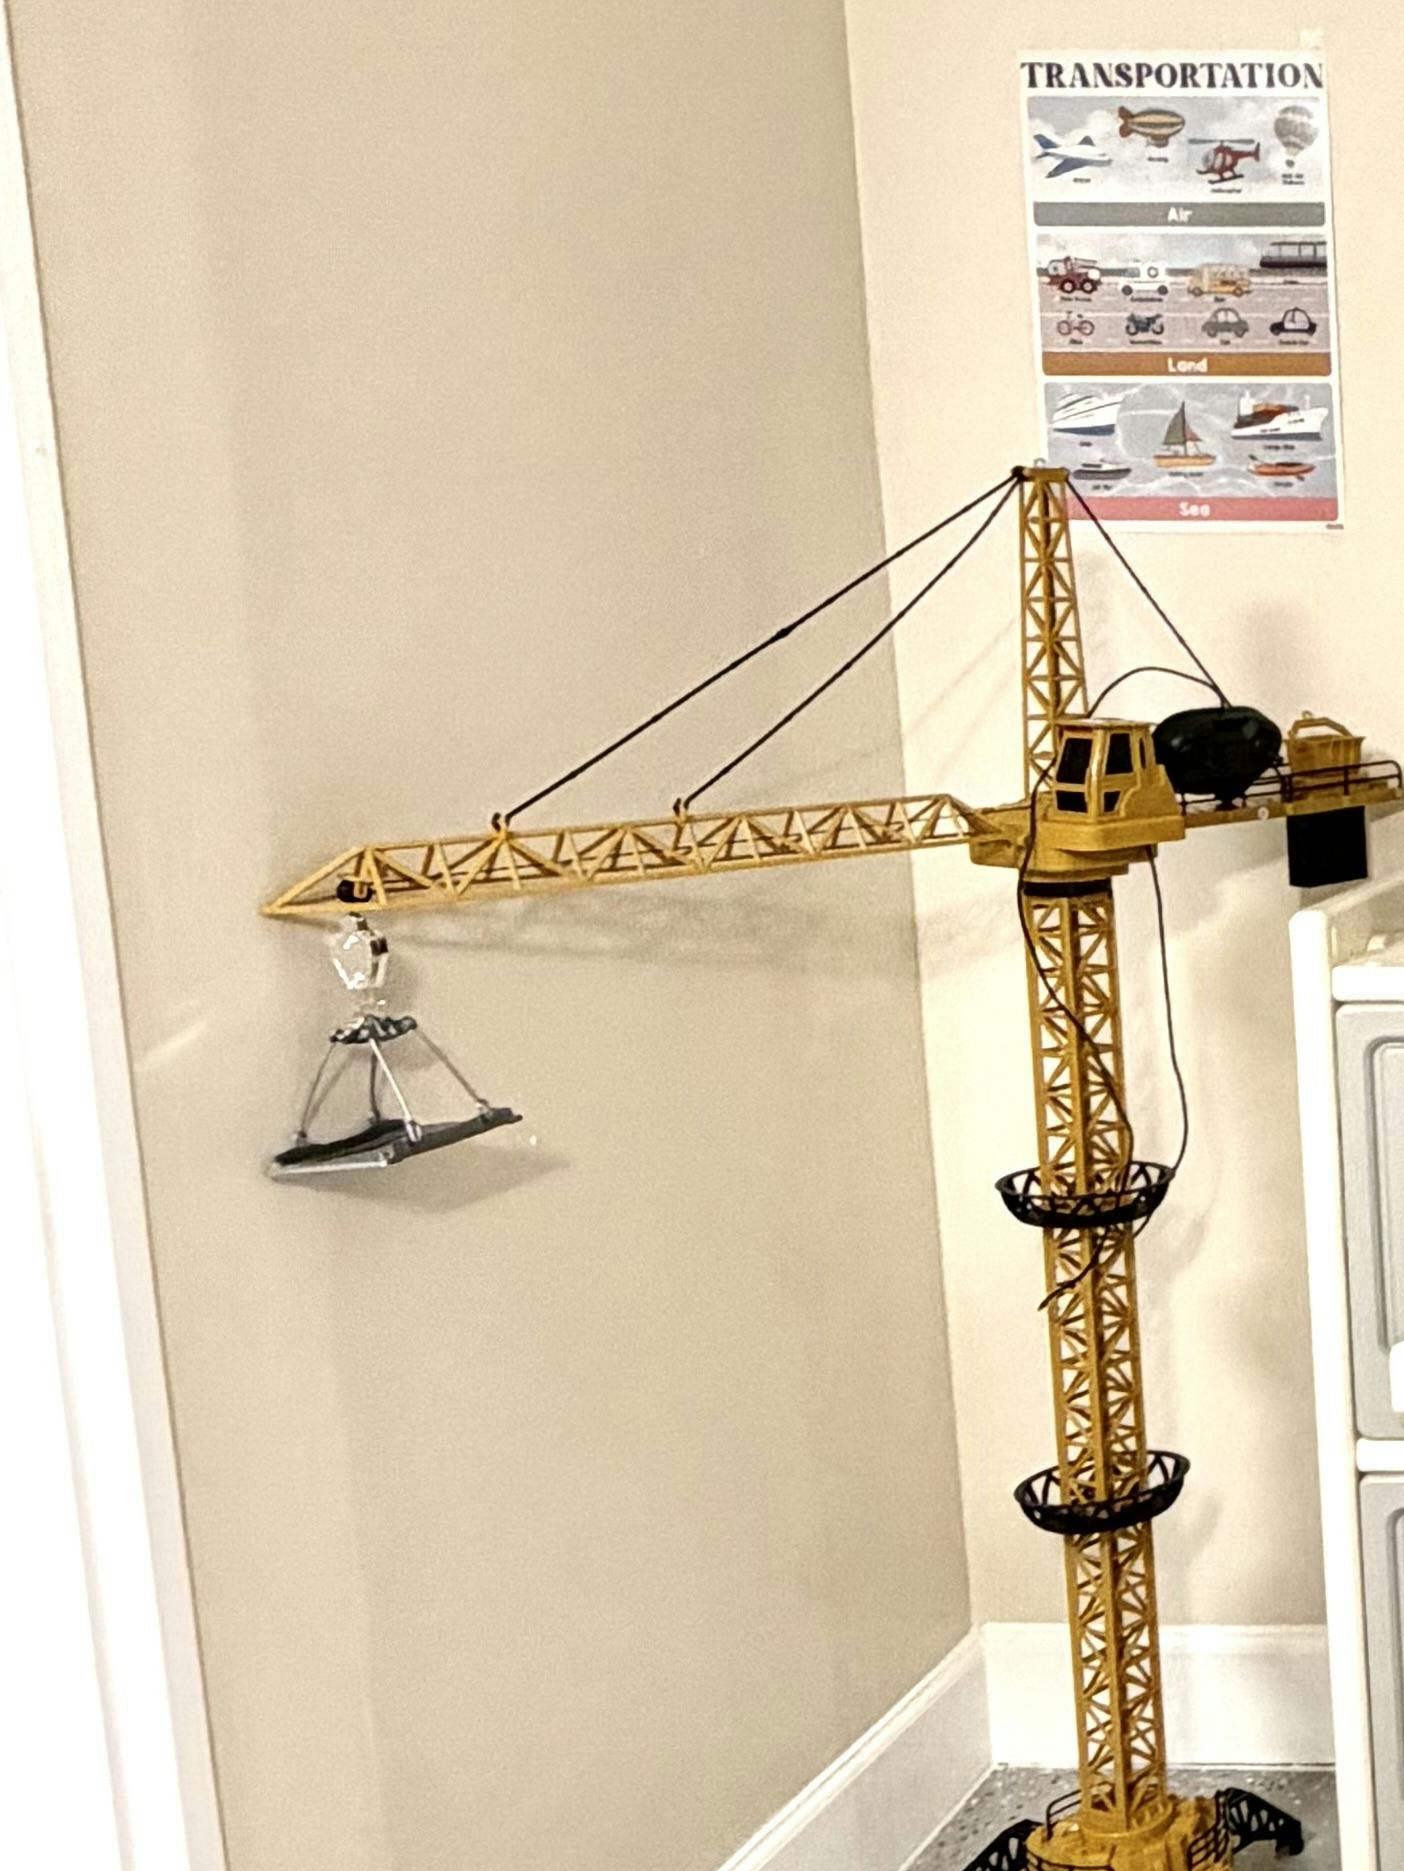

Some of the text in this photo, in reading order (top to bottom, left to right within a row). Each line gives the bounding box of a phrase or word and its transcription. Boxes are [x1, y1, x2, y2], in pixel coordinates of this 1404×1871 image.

[1020, 61, 1324, 89] TRANSPORTATION
[1167, 207, 1193, 223] Air
[1167, 357, 1208, 373] Land
[1178, 502, 1211, 518] Sea
